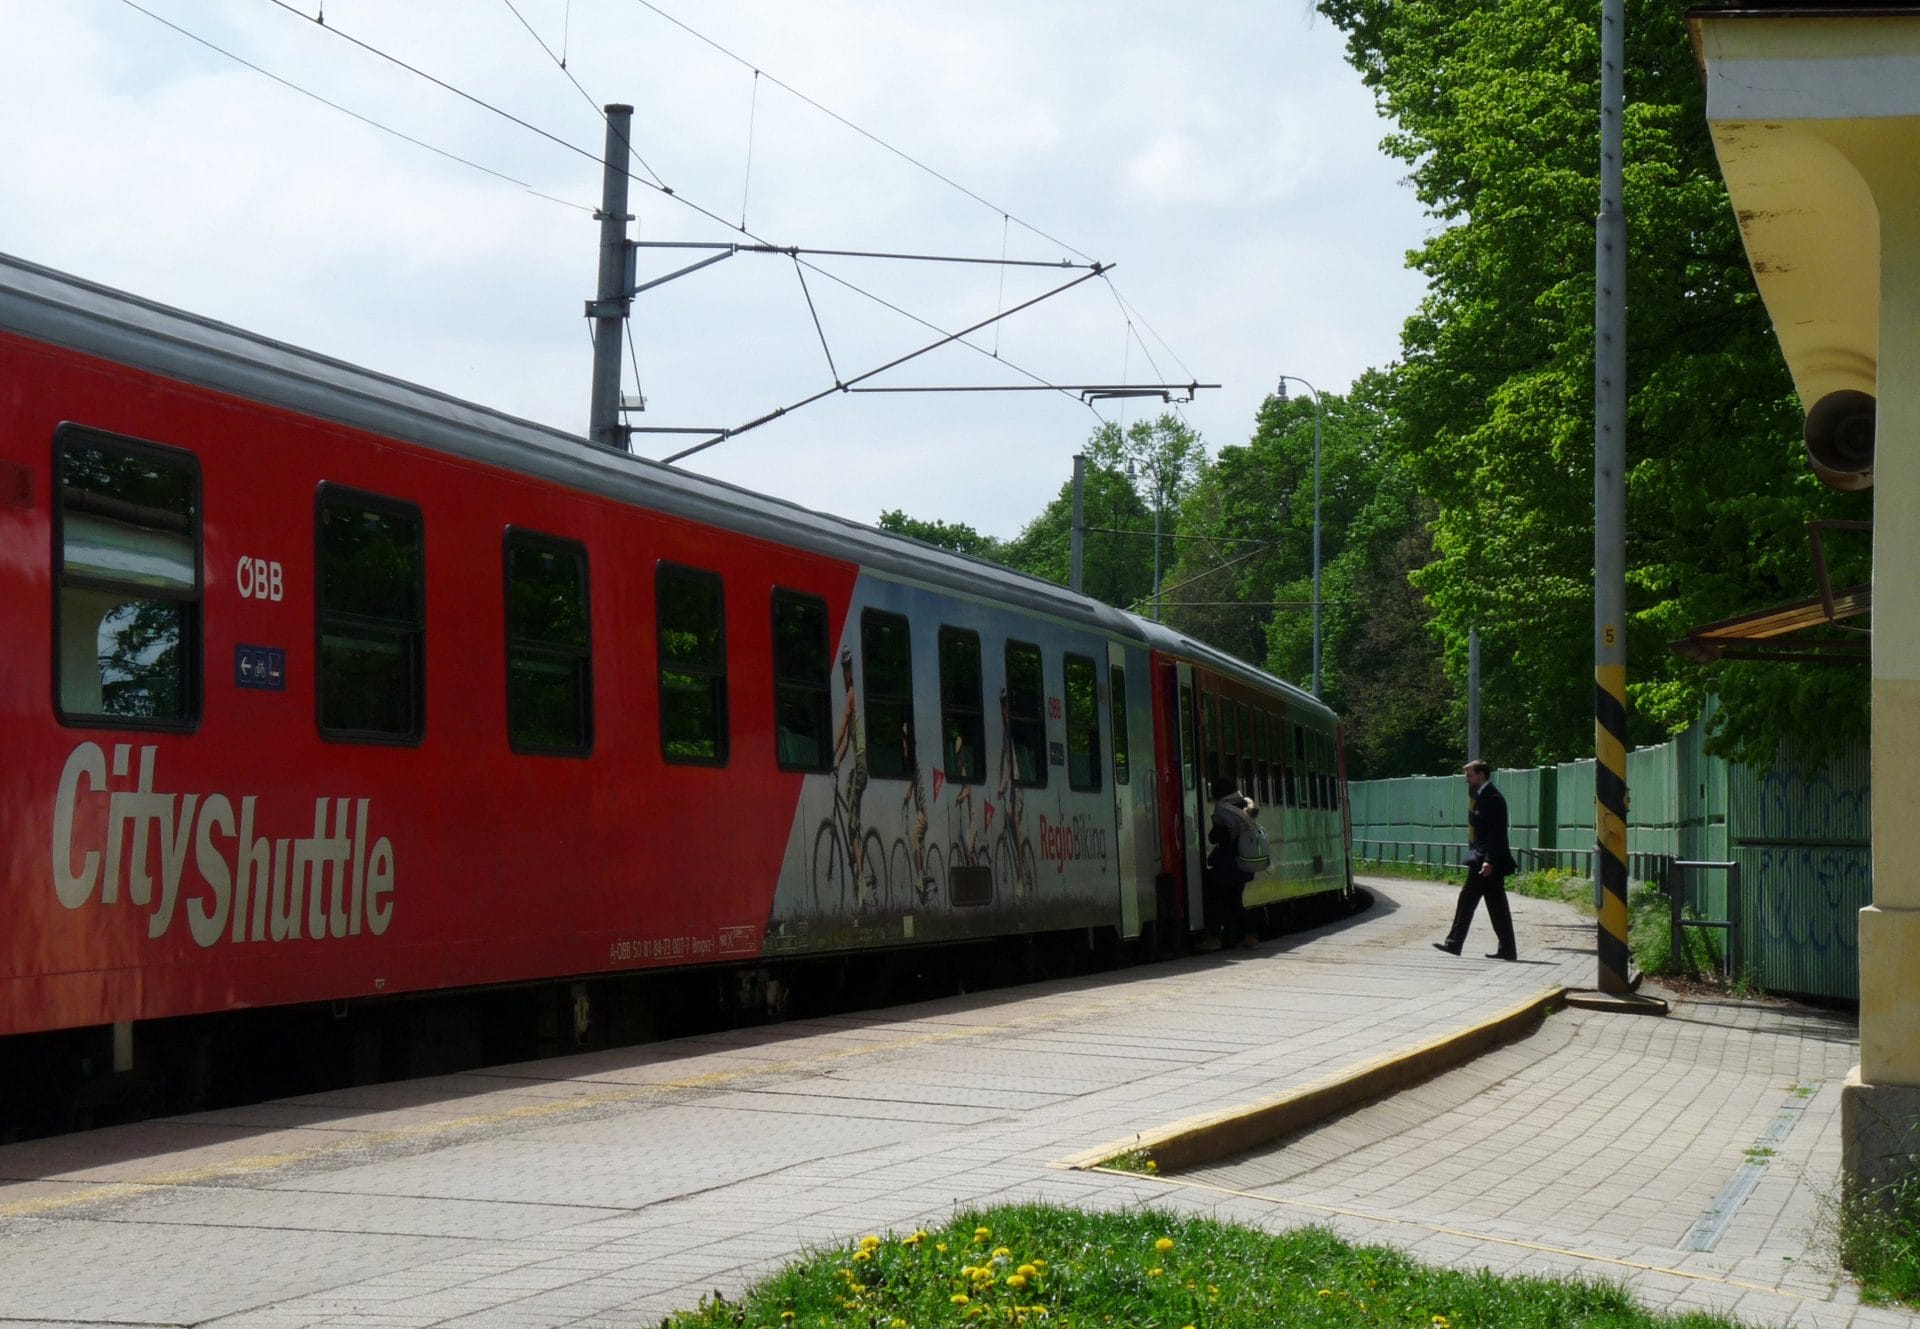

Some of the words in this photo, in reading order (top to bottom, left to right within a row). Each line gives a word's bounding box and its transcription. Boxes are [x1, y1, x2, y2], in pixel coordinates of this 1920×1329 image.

[236, 555, 284, 602] ÖBB
[1605, 628, 1615, 643] 5
[53, 741, 395, 947] CityShuttle
